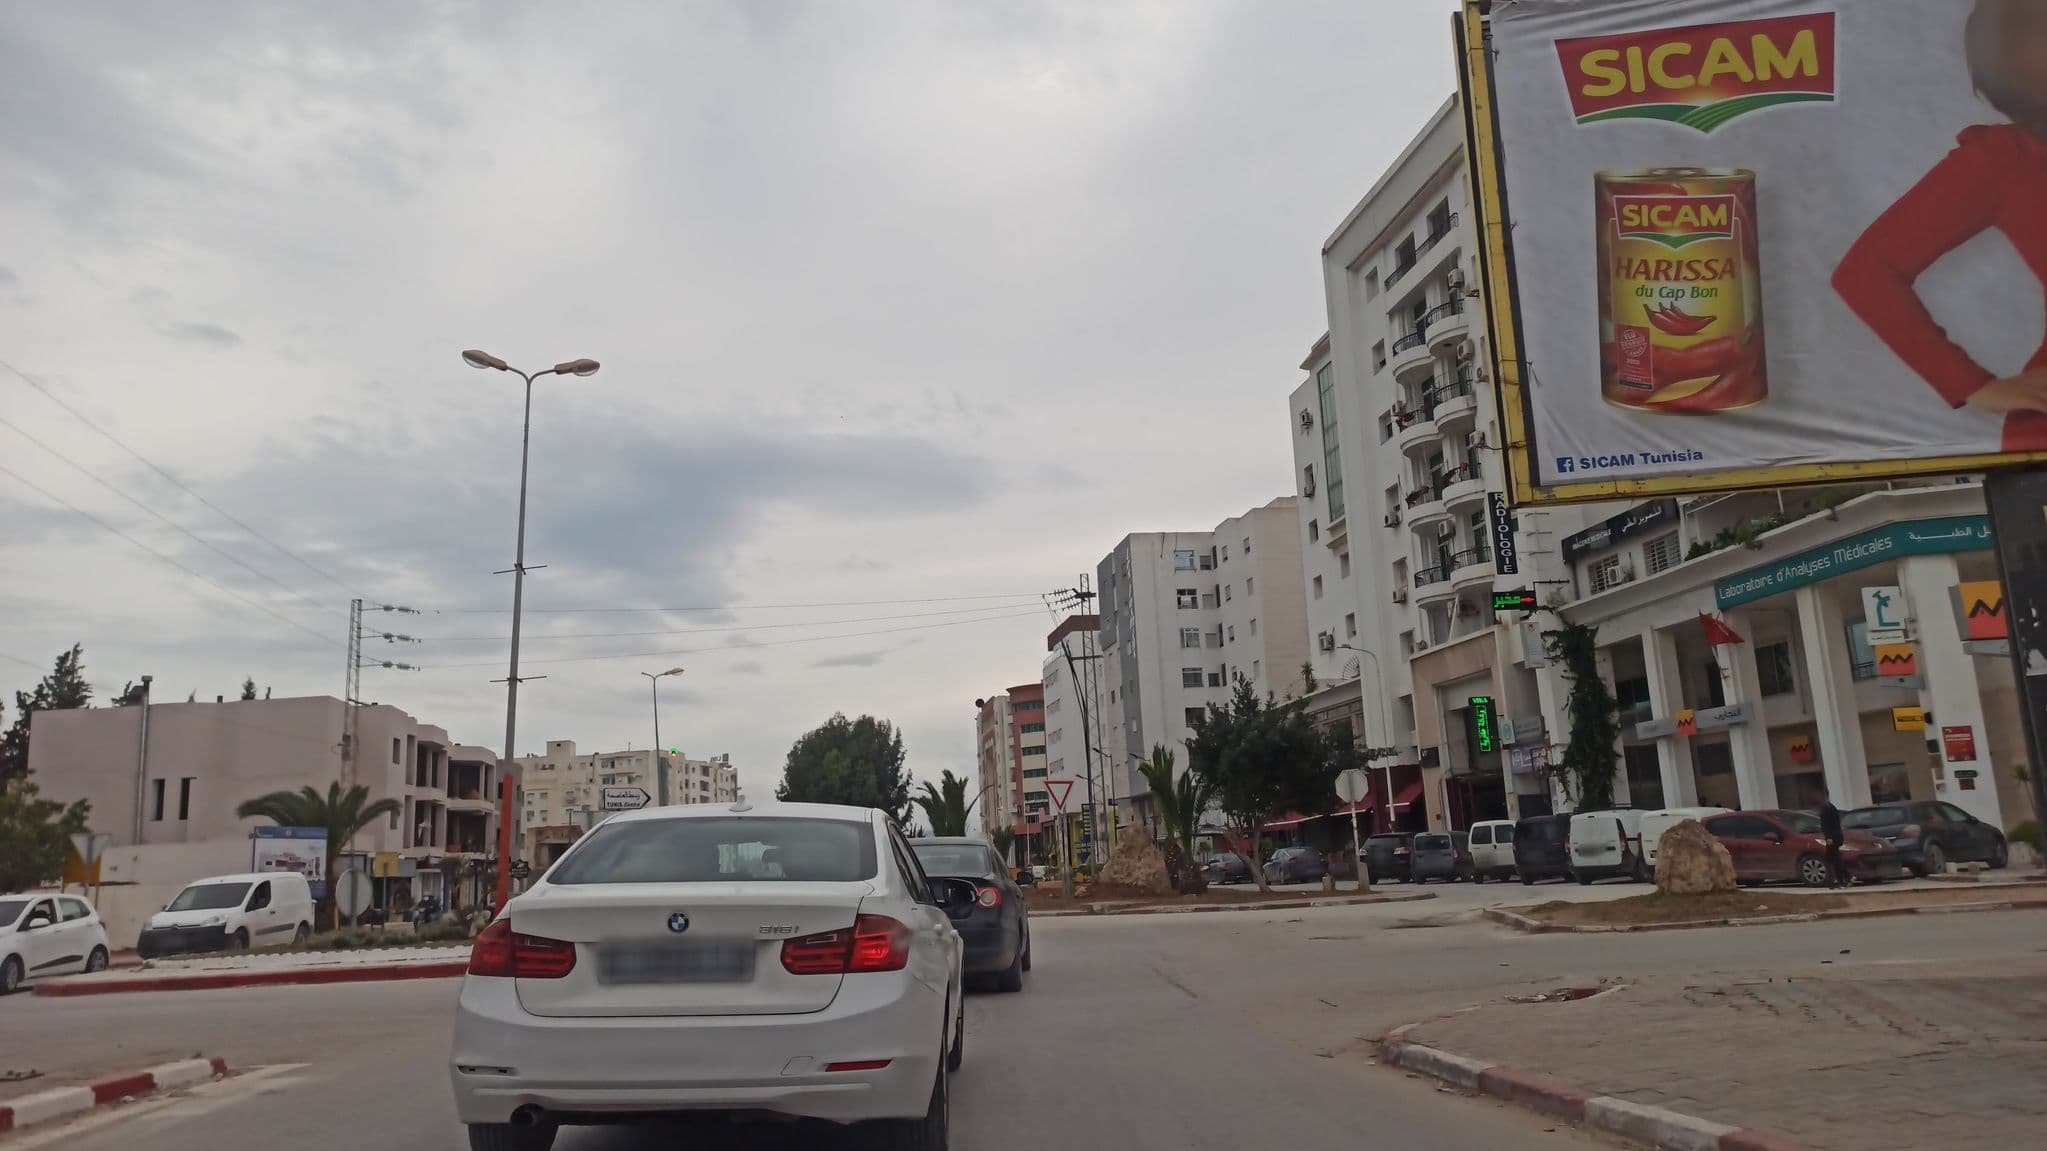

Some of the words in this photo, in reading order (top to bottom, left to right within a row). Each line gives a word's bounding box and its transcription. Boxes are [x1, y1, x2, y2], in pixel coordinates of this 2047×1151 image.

[1579, 29, 1819, 98] SICAM
[1622, 203, 1728, 228] SICAM
[1615, 257, 1737, 282] HARISSA
[1636, 285, 1653, 298] du
[1659, 286, 1685, 301] Cap
[1690, 286, 1719, 299] Bon
[1579, 453, 1635, 470] SICAM
[1639, 449, 1704, 466] Tunisia
[1494, 493, 1513, 573] RADIOLOGIE
[1718, 573, 1774, 600] Laboratoire
[1776, 555, 1831, 583] d'Analyses
[1834, 535, 1893, 565] Médicales
